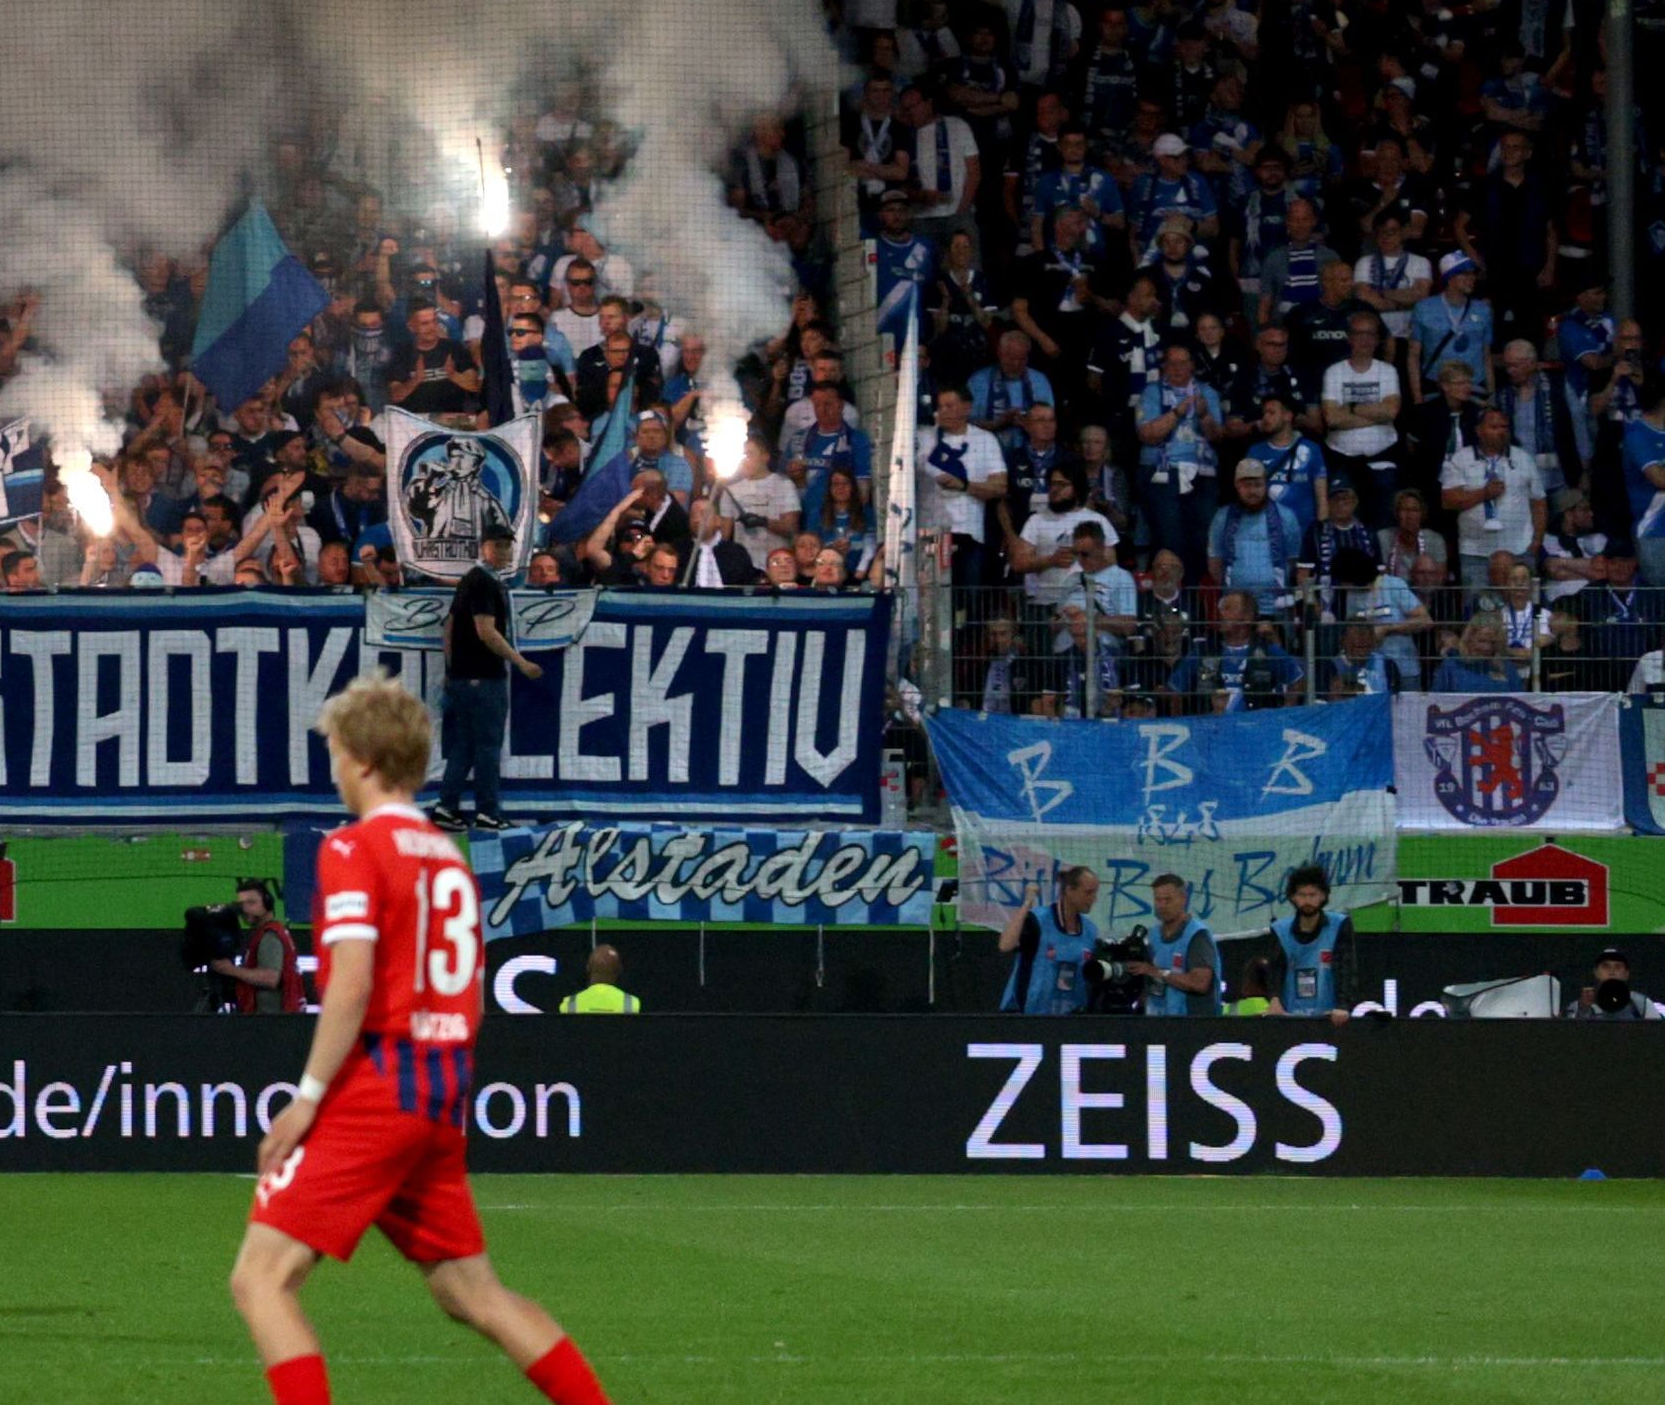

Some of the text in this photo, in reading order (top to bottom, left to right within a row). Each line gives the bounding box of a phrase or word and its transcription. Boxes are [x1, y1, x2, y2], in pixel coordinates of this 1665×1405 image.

[1007, 724, 1326, 823] B B B
[490, 821, 922, 926] Alstaden
[1233, 838, 1376, 915] Bohum
[1397, 880, 1586, 905] TRAUB
[414, 867, 479, 995] 13
[966, 1043, 1343, 1162] ZEISS
